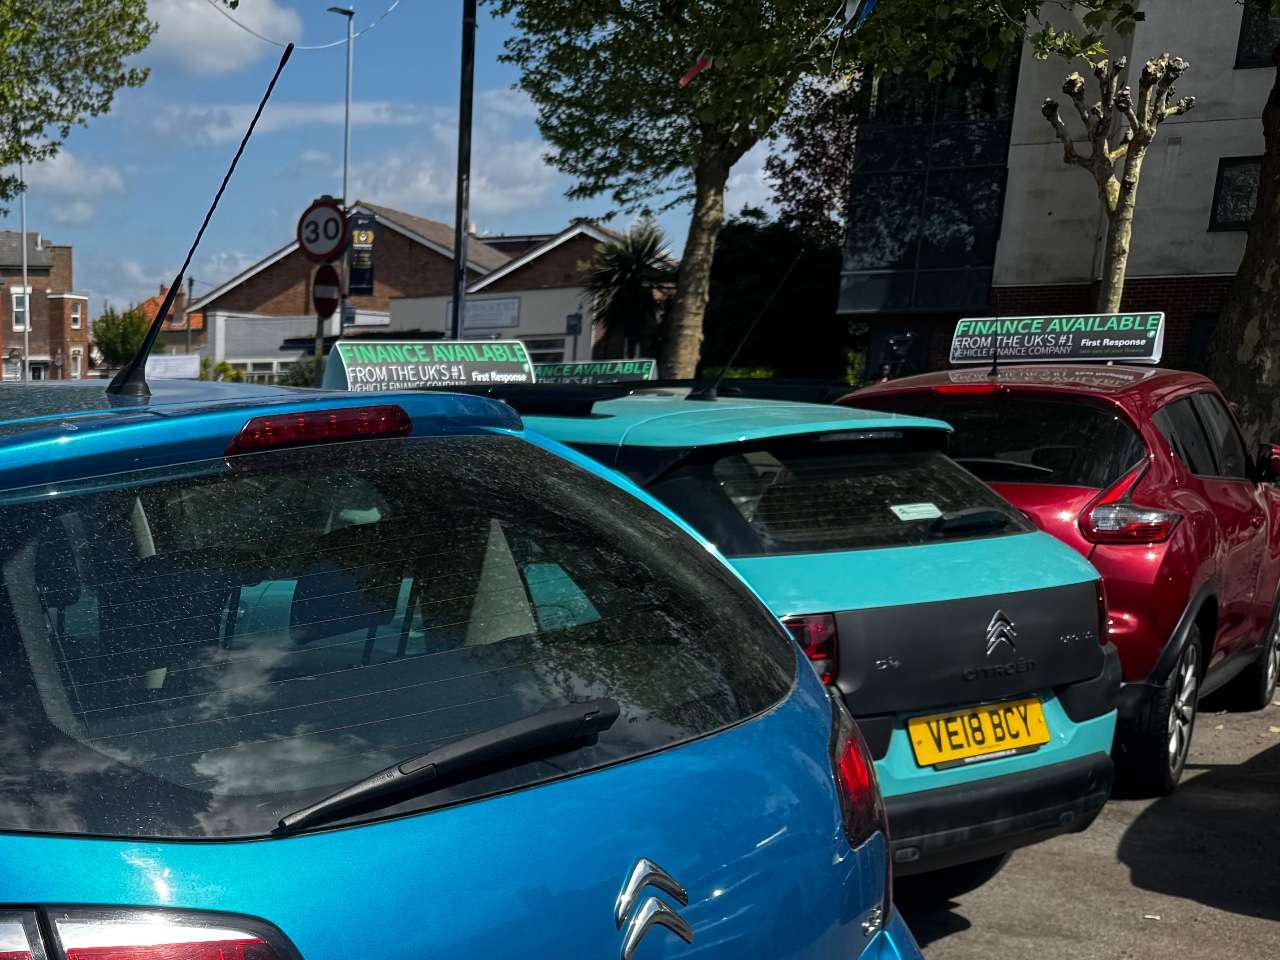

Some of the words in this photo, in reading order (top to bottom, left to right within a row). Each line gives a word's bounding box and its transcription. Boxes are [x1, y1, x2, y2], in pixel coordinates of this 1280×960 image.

[304, 217, 340, 244] 30
[957, 320, 1043, 335] FINANCE
[1046, 315, 1160, 332] AVAILABLE
[953, 336, 991, 349] FROM
[995, 335, 1022, 348] THE
[1024, 334, 1056, 347] UK'S
[1058, 334, 1073, 346] #1
[1080, 338, 1100, 347] First
[1102, 338, 1146, 348] Response
[340, 344, 431, 363] FINANCE
[433, 344, 527, 363] AVAILABLE
[952, 347, 989, 358] VEHICLE
[1028, 346, 1073, 355] COMPANY
[348, 365, 387, 383] FROM
[389, 366, 417, 382] THE
[419, 365, 448, 381] UK'S
[451, 365, 467, 380] #1
[472, 371, 489, 382] First
[491, 371, 527, 383] Response
[534, 365, 572, 377] ANCE
[574, 361, 651, 375] AVAILABLE
[927, 712, 985, 752] VE18
[988, 704, 1031, 742] BCY
